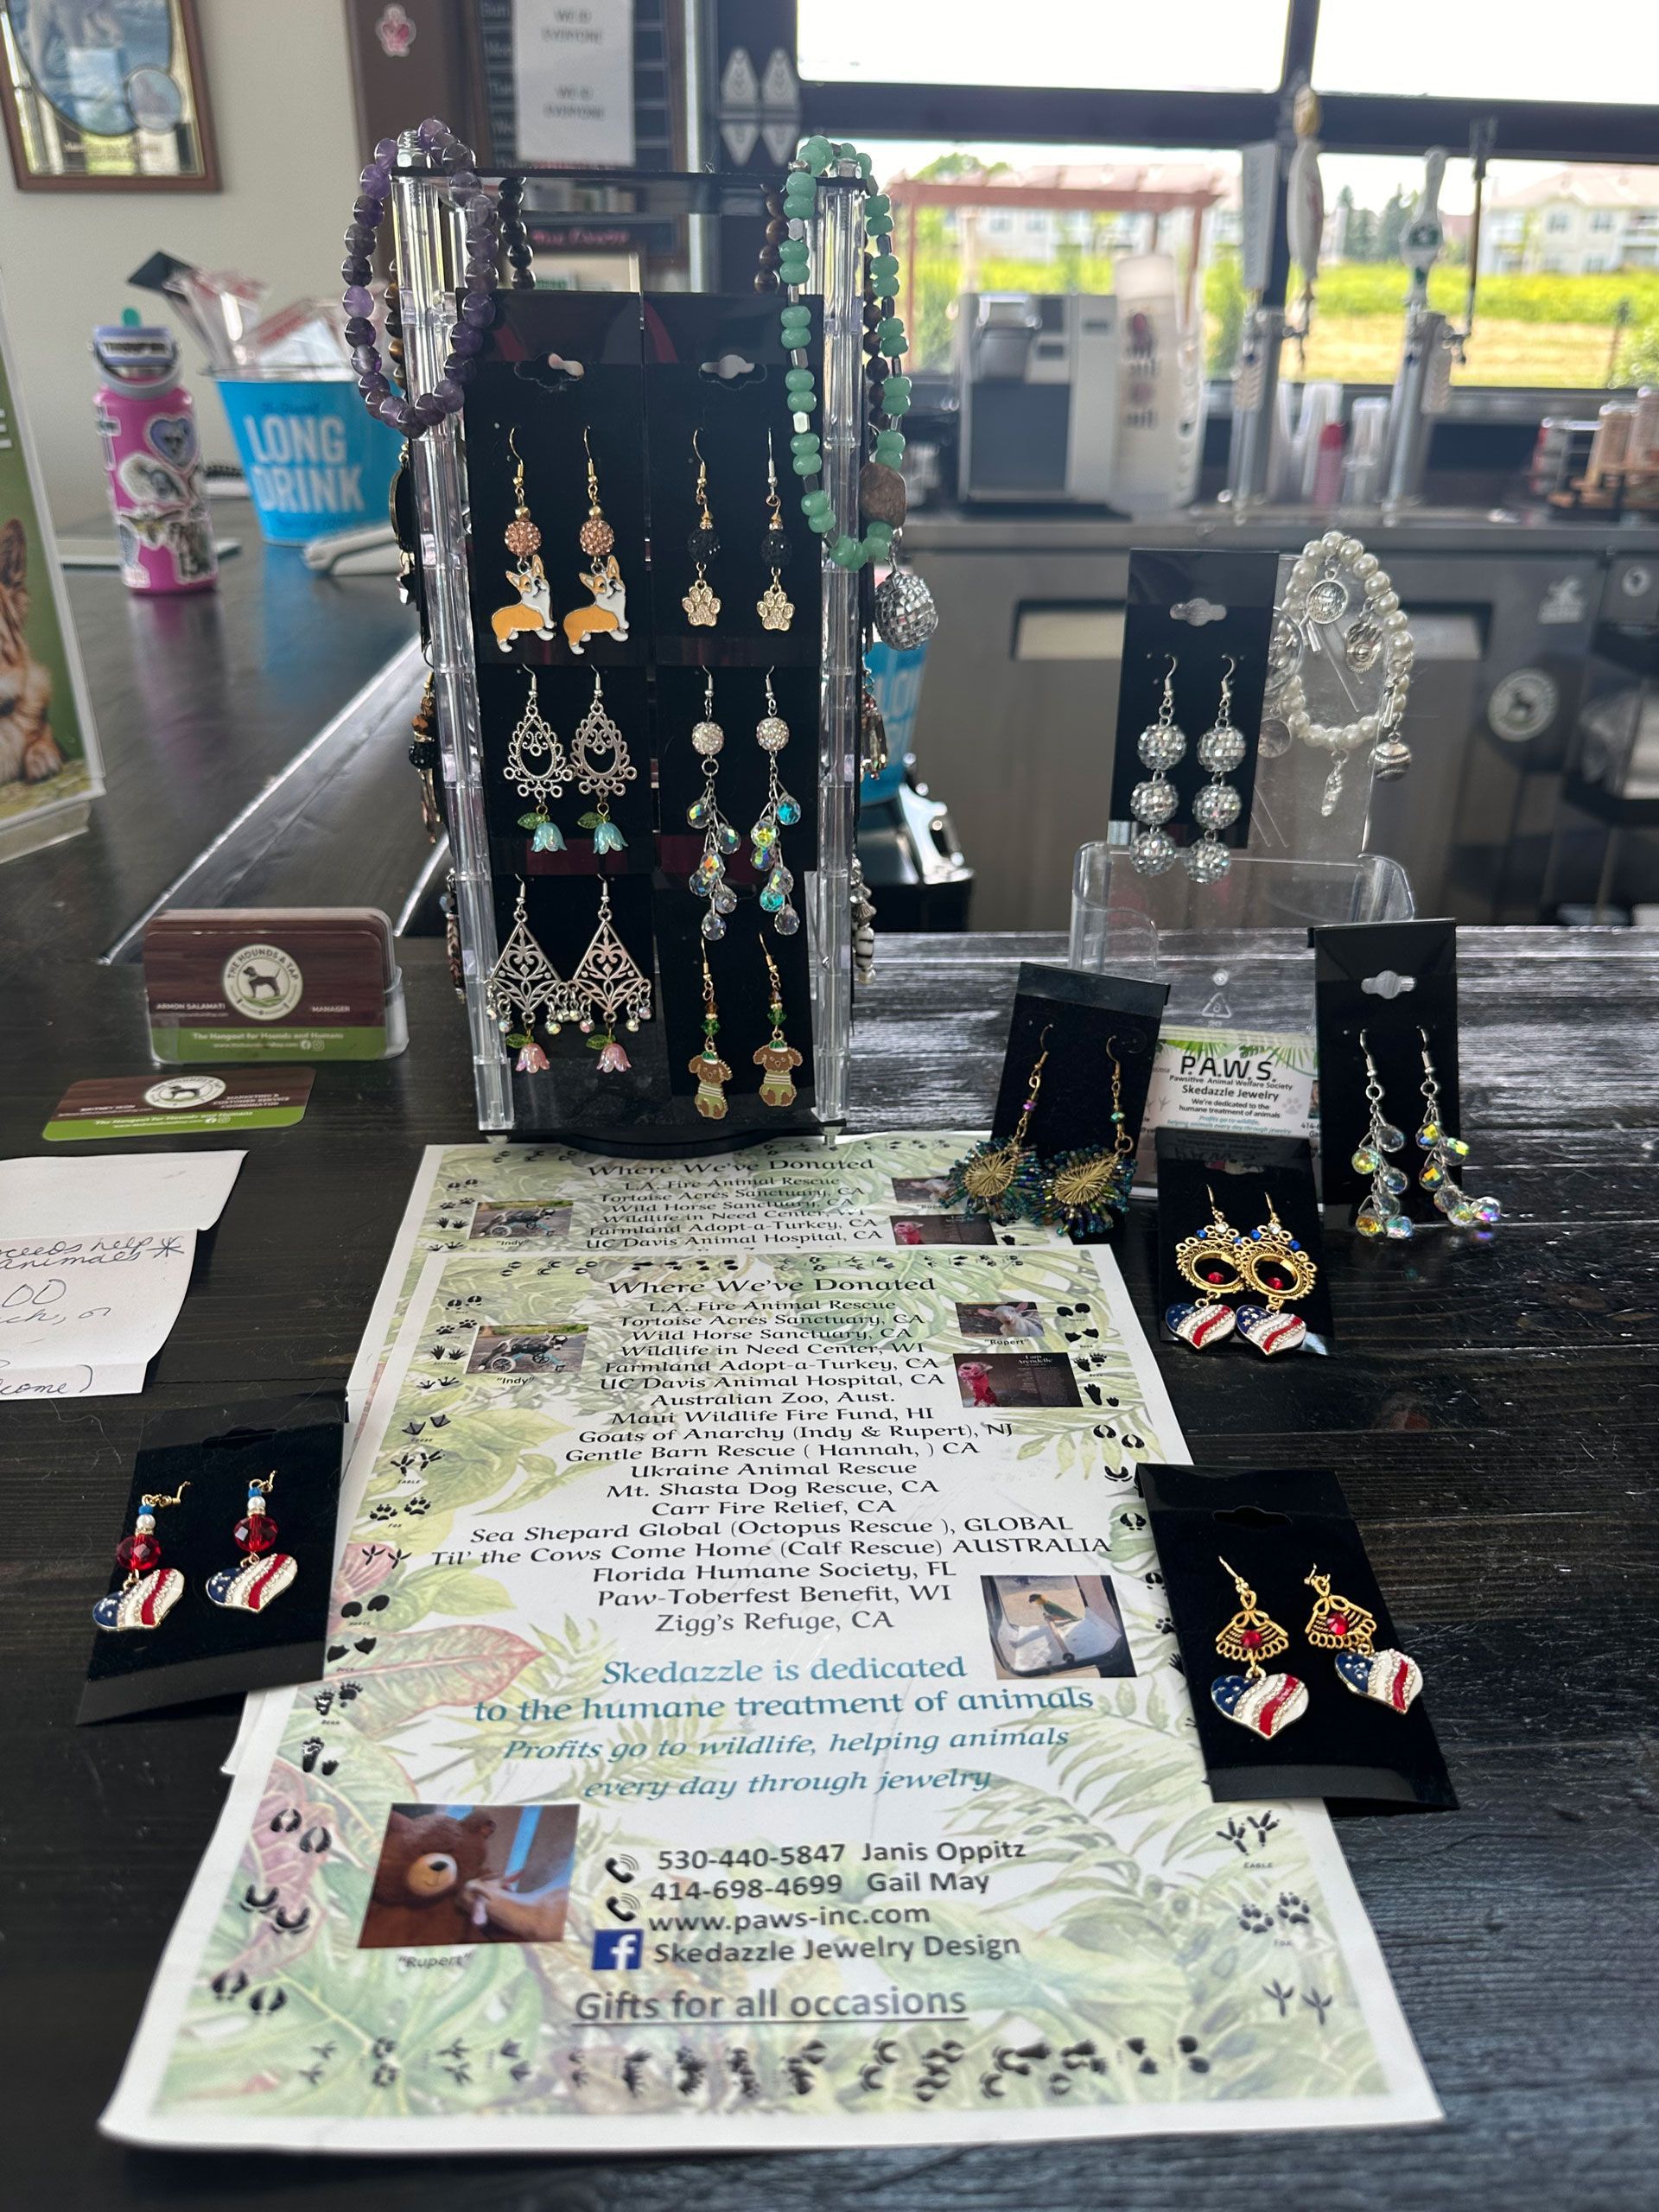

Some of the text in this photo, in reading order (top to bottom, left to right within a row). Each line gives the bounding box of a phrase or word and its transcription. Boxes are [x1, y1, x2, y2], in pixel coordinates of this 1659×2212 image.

[243, 414, 347, 464] LONG
[251, 465, 365, 513] DRINK
[238, 948, 279, 963] HOUNDS
[286, 961, 300, 981] TAP
[1180, 1055, 1277, 1083] P.A.W.S.
[1169, 1075, 1293, 1090] Pawsitive Animal Welfare Society
[1182, 1084, 1279, 1102] Skedazzle Jewelry
[1214, 1100, 1248, 1109] dedicated
[608, 1277, 938, 1294] Where We've Donated
[649, 1300, 896, 1312] L.A. Fire Animal Rescue
[620, 1313, 925, 1327] Tortoise Acres Sanctuary, CA
[632, 1328, 913, 1341] Wild Horse Sanctuary, CA
[621, 1343, 925, 1357] Wildlife in Need Center, WI
[606, 1357, 939, 1373] Farmland Adopt-a-Turkey, CA
[600, 1373, 945, 1390] UC Davis Animal Hospital, CA
[650, 1391, 895, 1406] Australian Zoo, Aust.
[611, 1408, 934, 1425] Maui Wildlife Fire Fund, HI
[579, 1423, 1013, 1444] Goats of Anarchy (Indy & Rupert), NJ
[631, 1462, 917, 1478] Ukraine Animal Rescue
[607, 1480, 940, 1497] Mt. Shasta Dog Rescue, CA
[652, 1500, 897, 1516] Carr Fire Relief, CA
[480, 1549, 522, 1564] the
[531, 1548, 601, 1562] Cows
[611, 1546, 686, 1560] Come
[695, 1542, 772, 1558] Home
[781, 1541, 842, 1557] (Calf
[850, 1539, 943, 1557] Rescue)
[951, 1537, 1113, 1554] AUSTRALIA
[593, 1560, 957, 1584] Florida Humane Society, FL
[597, 1584, 952, 1608] Paw-Toberfest Benefit, WI
[655, 1611, 895, 1637] Zigg's Refuge, CA
[601, 1656, 968, 1684] Skedazzle is dedicated
[474, 1687, 1094, 1722] to the humane treatment of animals
[503, 1727, 1070, 1763] Profits go to wildlife, helping animals
[584, 1768, 992, 1801] every day through jewelry
[658, 1840, 1027, 1872] 530-440-5847 Janis Oppitz
[650, 1871, 991, 1902] 414-698-4699 Gail May
[648, 1904, 931, 1935] www.paws-inc.com
[653, 1934, 1021, 1966] Skedazzle Jewelry Design
[575, 1986, 967, 2021] Gifts for all occasions
